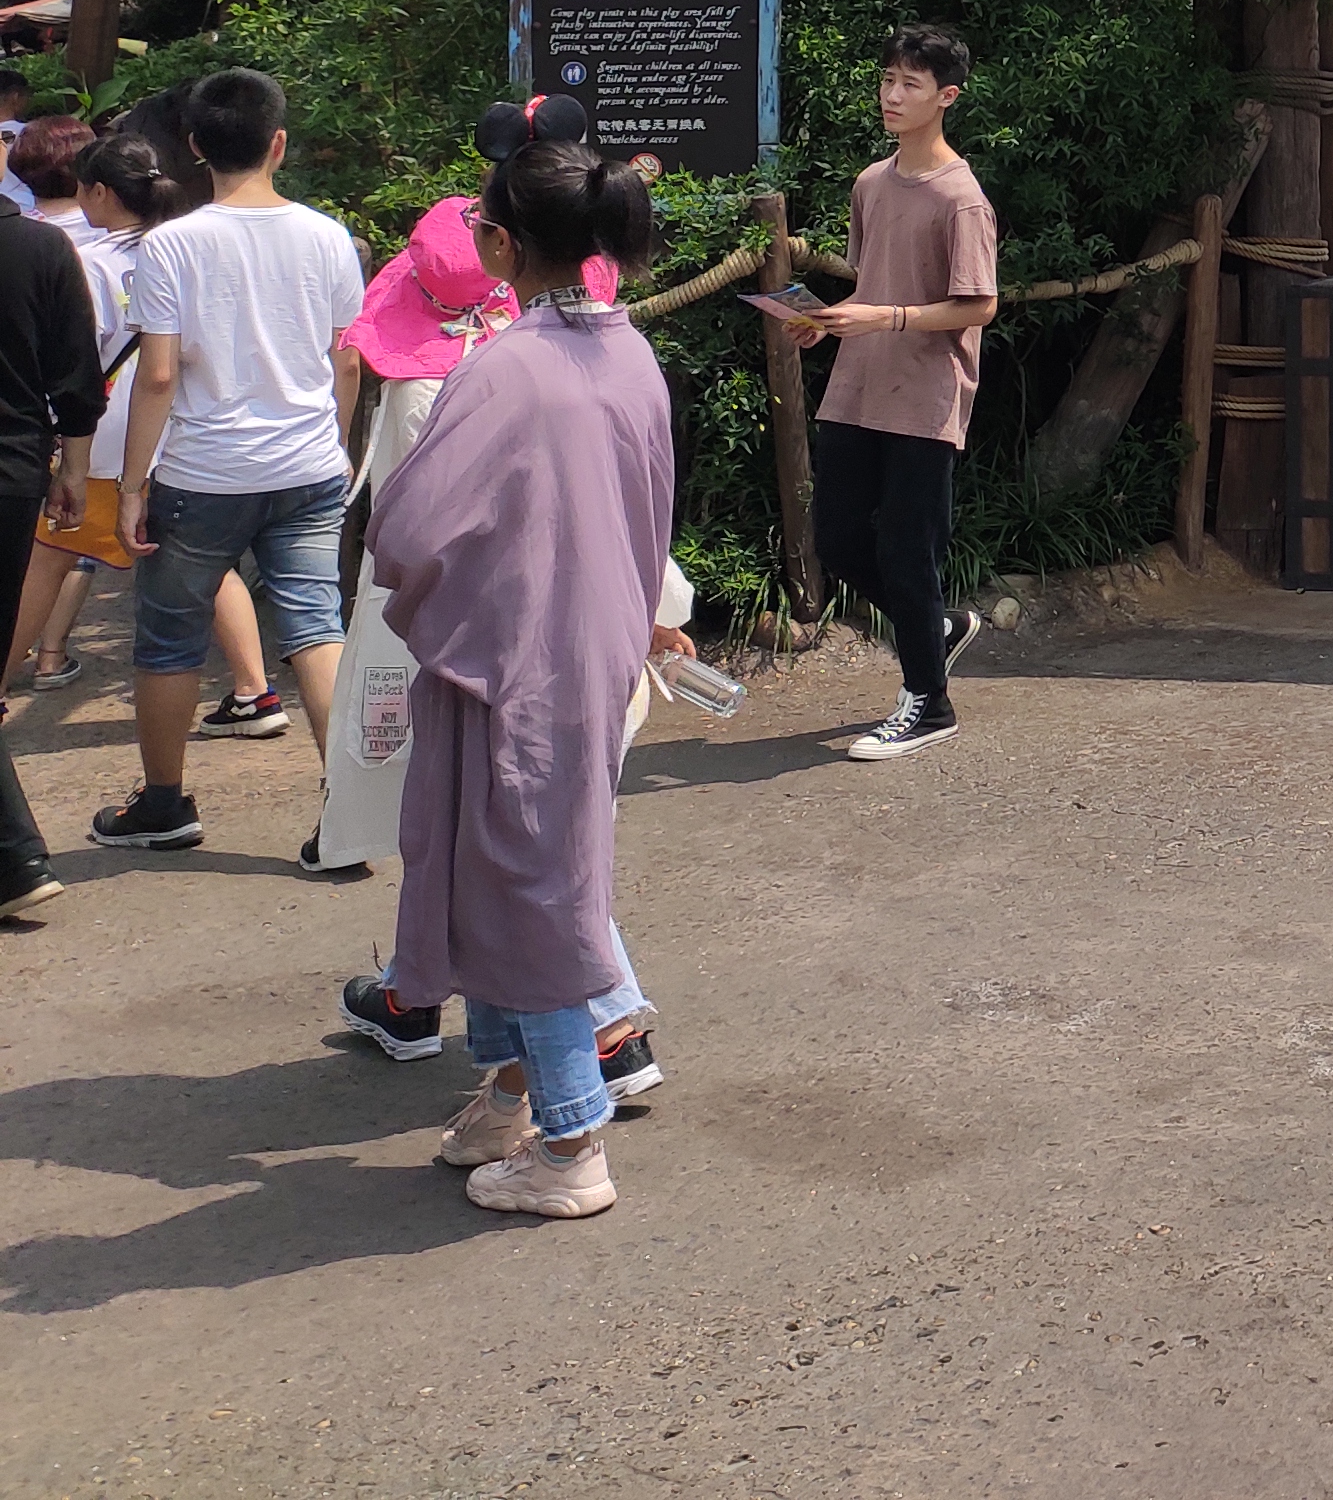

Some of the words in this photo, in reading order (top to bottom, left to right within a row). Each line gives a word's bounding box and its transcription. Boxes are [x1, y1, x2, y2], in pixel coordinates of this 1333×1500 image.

[550, 8, 575, 18] Come
[576, 7, 597, 20] play
[599, 8, 625, 20] pirate
[627, 8, 637, 17] in
[640, 7, 659, 17] this
[661, 7, 680, 20] play
[701, 6, 724, 18] full
[725, 6, 741, 19] of
[551, 19, 584, 32] splashy
[589, 19, 635, 28] interactive
[638, 20, 692, 32] experiences.
[695, 17, 732, 31] Younger
[549, 32, 580, 43] pirates
[584, 32, 600, 40] can
[602, 31, 627, 43] enjoy
[625, 30, 648, 43] fun
[651, 29, 686, 43] sea-life
[688, 29, 742, 39] discoveries.
[550, 42, 589, 55] Getting
[590, 43, 605, 51] wet
[608, 42, 618, 51] is
[630, 41, 667, 55] definite
[668, 40, 719, 55] possibility!
[596, 60, 643, 73] Supervise
[645, 60, 683, 70] children
[685, 62, 695, 70] at
[698, 60, 711, 70] all
[713, 61, 742, 70] times.
[597, 73, 639, 83] Children
[641, 72, 669, 82] under
[670, 75, 687, 84] age
[688, 72, 698, 82] 7
[695, 74, 724, 83] years
[597, 86, 621, 94] must
[624, 84, 634, 94] be
[636, 84, 690, 96] accompanied
[693, 84, 703, 96] by
[595, 98, 627, 110] person
[629, 98, 646, 109] age
[648, 97, 661, 105] 16
[660, 97, 689, 107] years
[703, 94, 729, 105] older.
[596, 133, 648, 145] Wheelchair
[649, 136, 680, 144] access
